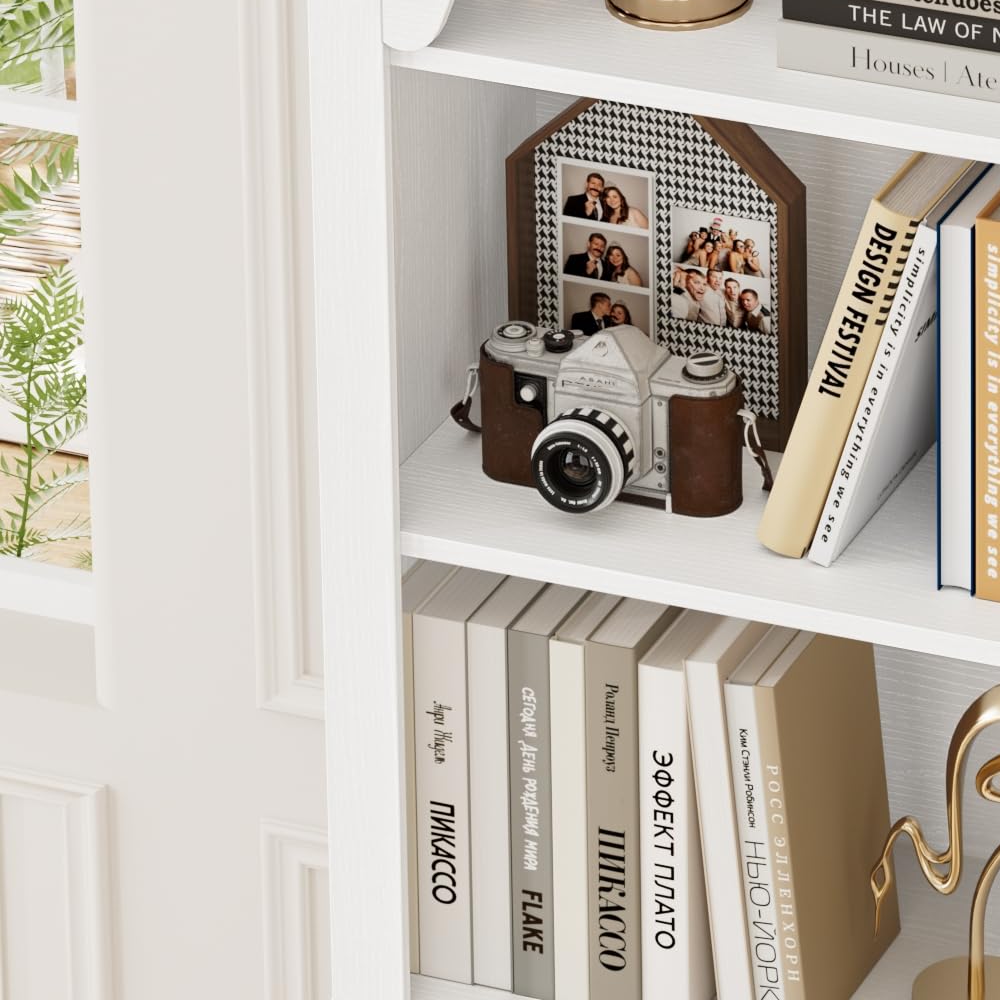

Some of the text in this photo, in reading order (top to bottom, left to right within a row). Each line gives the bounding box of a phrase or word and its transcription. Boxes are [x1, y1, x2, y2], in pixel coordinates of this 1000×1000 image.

[848, 4, 893, 27] THE
[901, 12, 946, 36] LAW
[955, 21, 982, 41] OF
[850, 45, 936, 81] Houses
[818, 222, 898, 399] DESIGN FESTIVAL
[821, 247, 925, 544] simplicity is in everything we see
[986, 513, 1000, 540] we
[986, 545, 1000, 580] see
[518, 686, 539, 872] СЕГОДНЯ ДЕНЬ РОЖДЕНИЯ МИРА
[602, 682, 620, 774] Роланд Пенроуз
[738, 728, 756, 829] Ким Стэнли Робинсон
[429, 800, 457, 905] ПИКАССО
[597, 826, 627, 973] ПИКАССО
[652, 749, 676, 950] ЭФФЕКТ ПЛАТО
[765, 763, 801, 983] РОСС ЭЛЛЕНХОРН
[521, 889, 544, 955] FLAKE
[744, 840, 780, 1000] НЬЮ-ЙОРК
